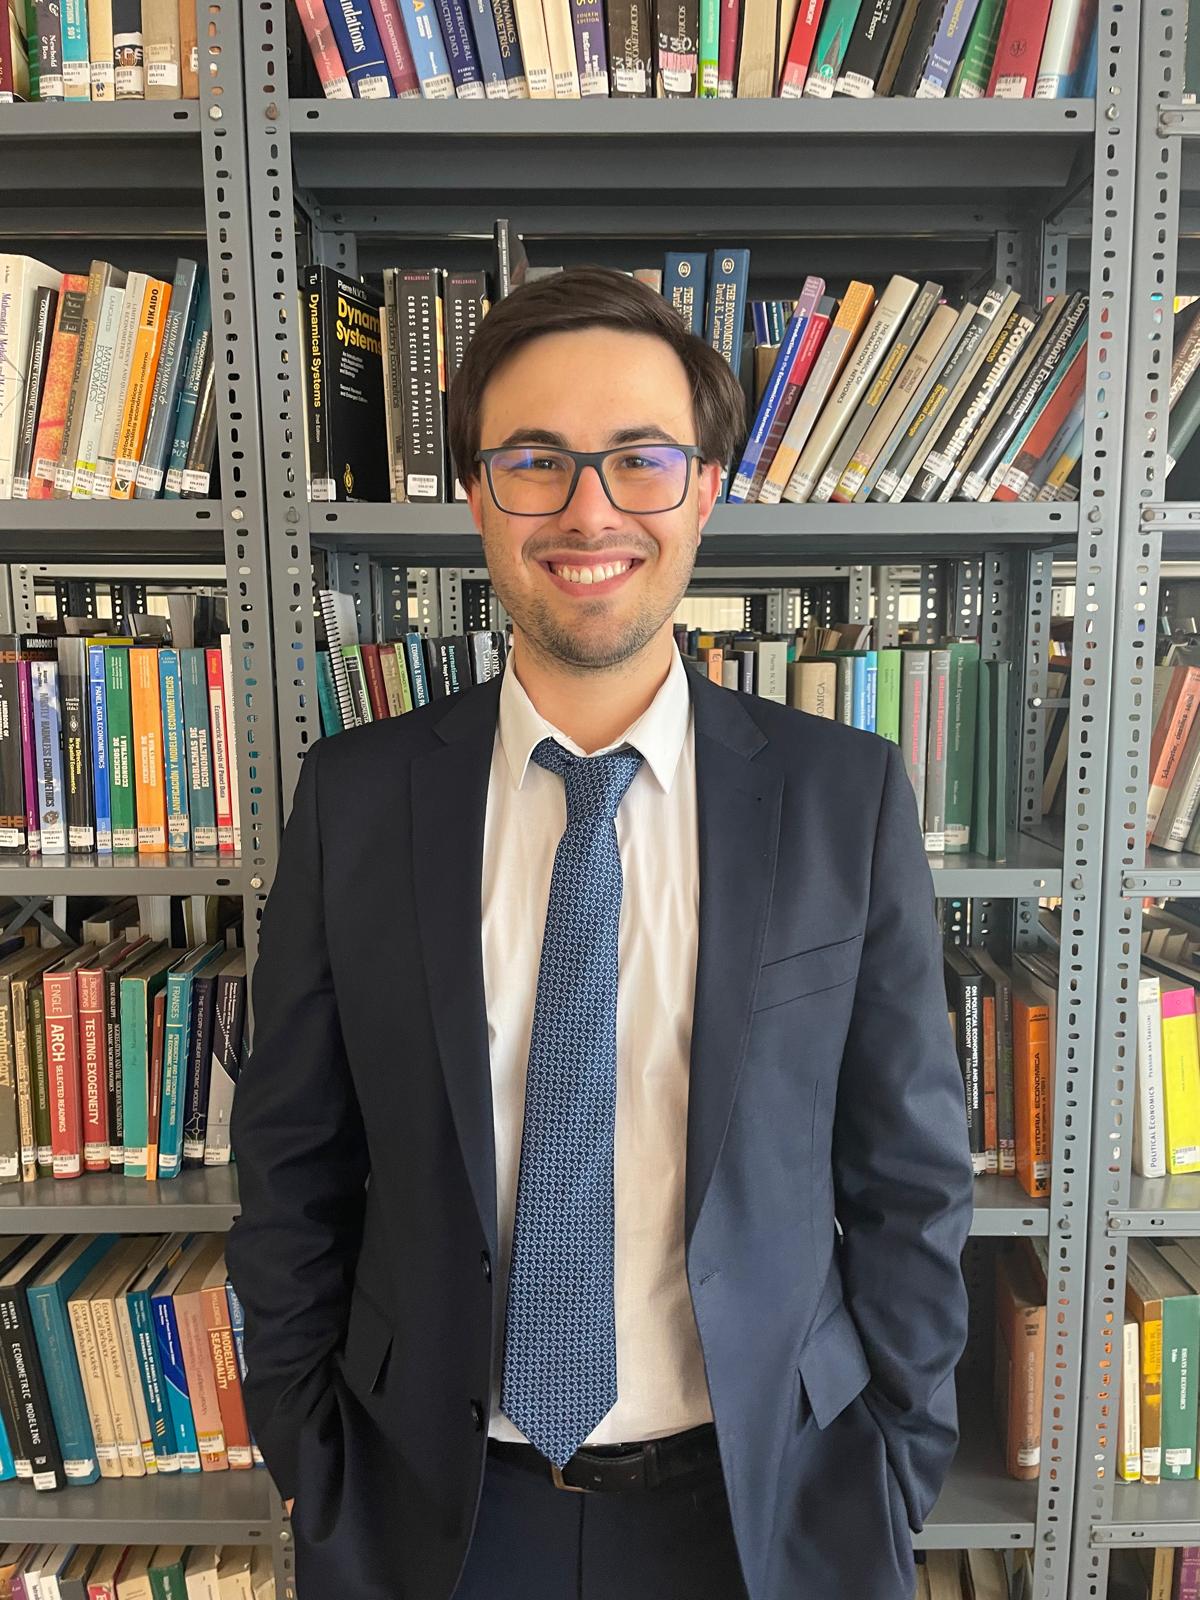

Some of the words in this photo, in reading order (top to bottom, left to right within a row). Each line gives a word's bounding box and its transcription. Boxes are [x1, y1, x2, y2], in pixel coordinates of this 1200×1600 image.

[383, 13, 404, 71] Econometrics
[454, 4, 472, 61] STRUCTURAL
[866, 11, 883, 40] Theory
[50, 35, 58, 68] Newbold
[449, 34, 459, 58] DATA
[309, 273, 317, 285] Tu
[684, 287, 693, 305] THE
[716, 284, 725, 305] David
[37, 299, 46, 334] GOODWIN
[129, 303, 138, 330] LIMITED
[147, 288, 158, 327] NIKAIDO
[309, 293, 320, 356] Dynamical
[407, 295, 415, 327] CROSS
[454, 299, 463, 330] CROSS
[715, 306, 722, 314] K.
[799, 307, 806, 317] An
[167, 311, 182, 357] NONLINEAR
[388, 305, 397, 353] Introductory
[420, 295, 432, 374] ECONOMETRIC
[714, 315, 722, 340] Levine
[724, 302, 734, 350] ECONOMICS
[786, 317, 803, 355] Introduction
[855, 320, 884, 367] INFORMATION
[880, 323, 891, 337] THE
[1042, 294, 1092, 370] Computational
[32, 341, 41, 372] CHAOTIC
[72, 318, 89, 386] MATHEMATICAL
[124, 330, 133, 366] DEPENDENT
[194, 331, 209, 381] INTRODUCTION
[408, 332, 417, 372] SECTION
[858, 337, 884, 377] ECONOMICS
[982, 316, 1035, 395] Economic
[986, 329, 1009, 364] ORMEROD
[28, 374, 37, 409] ECONOMIC
[87, 345, 105, 402] ECONOMICS
[95, 346, 111, 422] MATHEMATICAL
[133, 383, 144, 421] económico
[140, 351, 148, 383] moderno
[159, 357, 173, 395] DYNAMICS
[193, 381, 199, 392] TO
[312, 357, 322, 408] Systems
[410, 378, 418, 396] AND
[769, 372, 784, 402] Economics
[834, 367, 860, 405] NETWORKS
[423, 382, 434, 436] ANALYSIS
[1012, 368, 1049, 423] Economics
[24, 410, 33, 444] DYNAMICS
[61, 389, 78, 456] ECONOMICS
[411, 400, 419, 428] PANEL
[754, 408, 771, 444] Information
[122, 428, 132, 459] métodos
[412, 432, 420, 455] DATA
[427, 443, 434, 456] OF
[410, 643, 422, 669] ECONOMÍA
[447, 646, 460, 687] International
[165, 676, 177, 731] ECONOMÉTRICOS
[414, 674, 426, 699] FINANZAS
[40, 692, 49, 720] MOSTLY
[214, 705, 222, 739] Econometric
[42, 720, 51, 757] HARMLESS
[97, 722, 105, 769] ECONOMETRICS
[113, 737, 119, 747] DE
[168, 731, 178, 763] MODELOS
[190, 727, 198, 739] DE
[216, 739, 224, 762] Analysis
[121, 741, 129, 788] ECONOMETRÍA
[191, 739, 201, 790] PROBLEMAS
[199, 728, 209, 788] ECONOMETRÍA
[44, 757, 54, 808] ECONOMETRICS
[50, 984, 63, 1013] ENGLE
[170, 986, 181, 1019] FRANSES
[971, 986, 977, 996] ON
[51, 1023, 65, 1062] ARCH
[84, 1018, 97, 1061] TESTING
[196, 1029, 202, 1038] OF
[56, 1064, 64, 1098] SELECTED
[86, 1062, 101, 1125] EXOGENEITY
[57, 1098, 66, 1134] READINGS
[1147, 1087, 1156, 1130] ECONOMICS
[1149, 1132, 1157, 1168] POLITICAL
[1, 1303, 10, 1330] NIELSEN
[8, 1301, 18, 1324] HENDRY
[72, 1303, 84, 1331] Cyclical
[93, 1303, 105, 1330] Cyclical
[79, 1302, 94, 1344] Econometric
[87, 1344, 99, 1370] Models
[100, 1302, 116, 1343] Econometric
[110, 1344, 122, 1370] Models
[210, 1332, 228, 1390] SEASONALITY
[220, 1331, 237, 1382] MODELLING
[11, 1342, 32, 1400] ECONOMETRIC
[24, 1402, 42, 1445] MODELING
